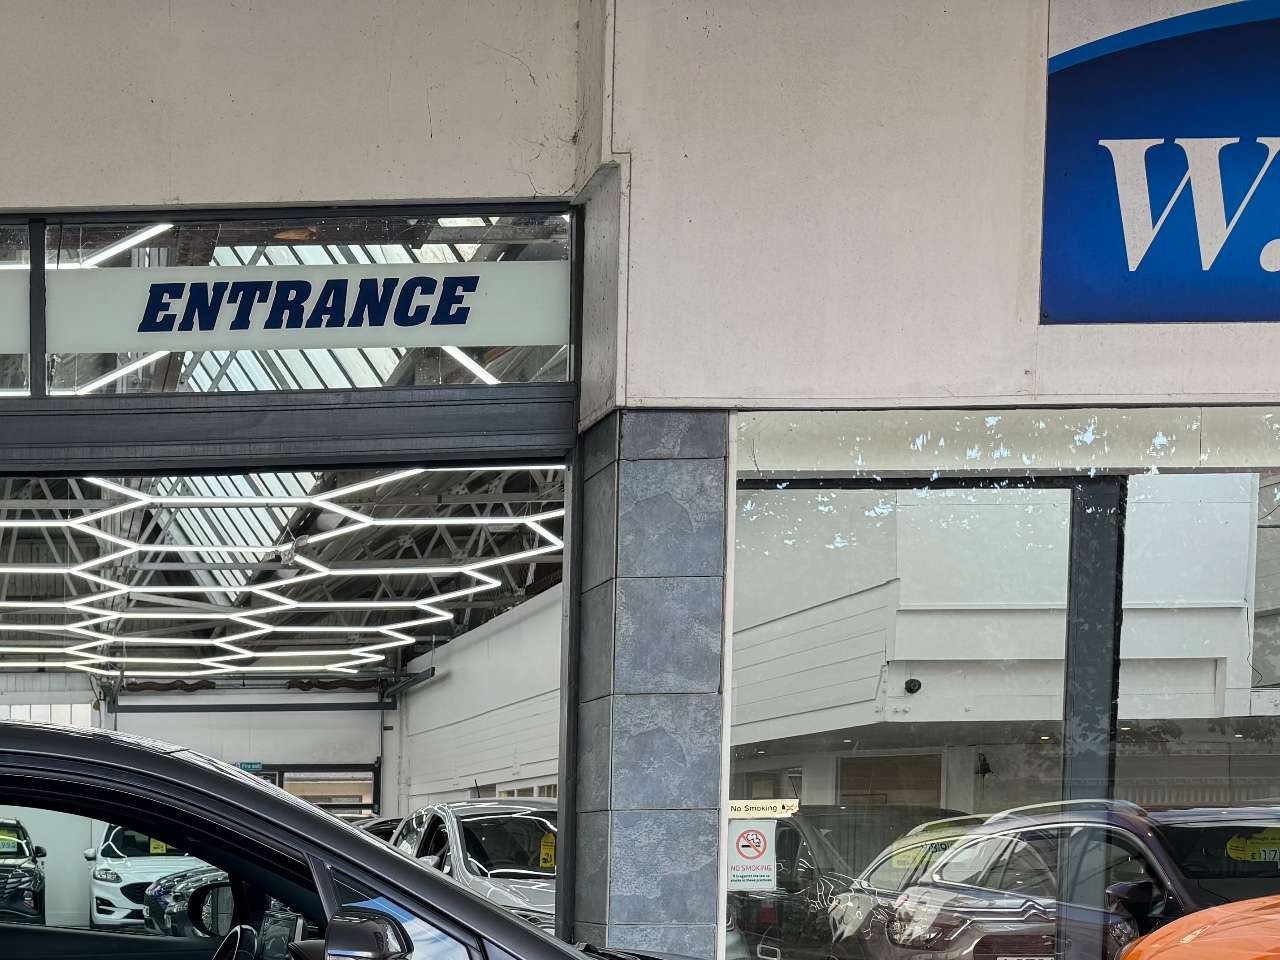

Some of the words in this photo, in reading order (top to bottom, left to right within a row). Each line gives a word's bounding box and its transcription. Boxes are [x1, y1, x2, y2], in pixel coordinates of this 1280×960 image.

[137, 275, 480, 333] ENTRANCE
[730, 805, 742, 813] No
[744, 804, 778, 813] Smoking
[740, 864, 772, 872] SMOKING
